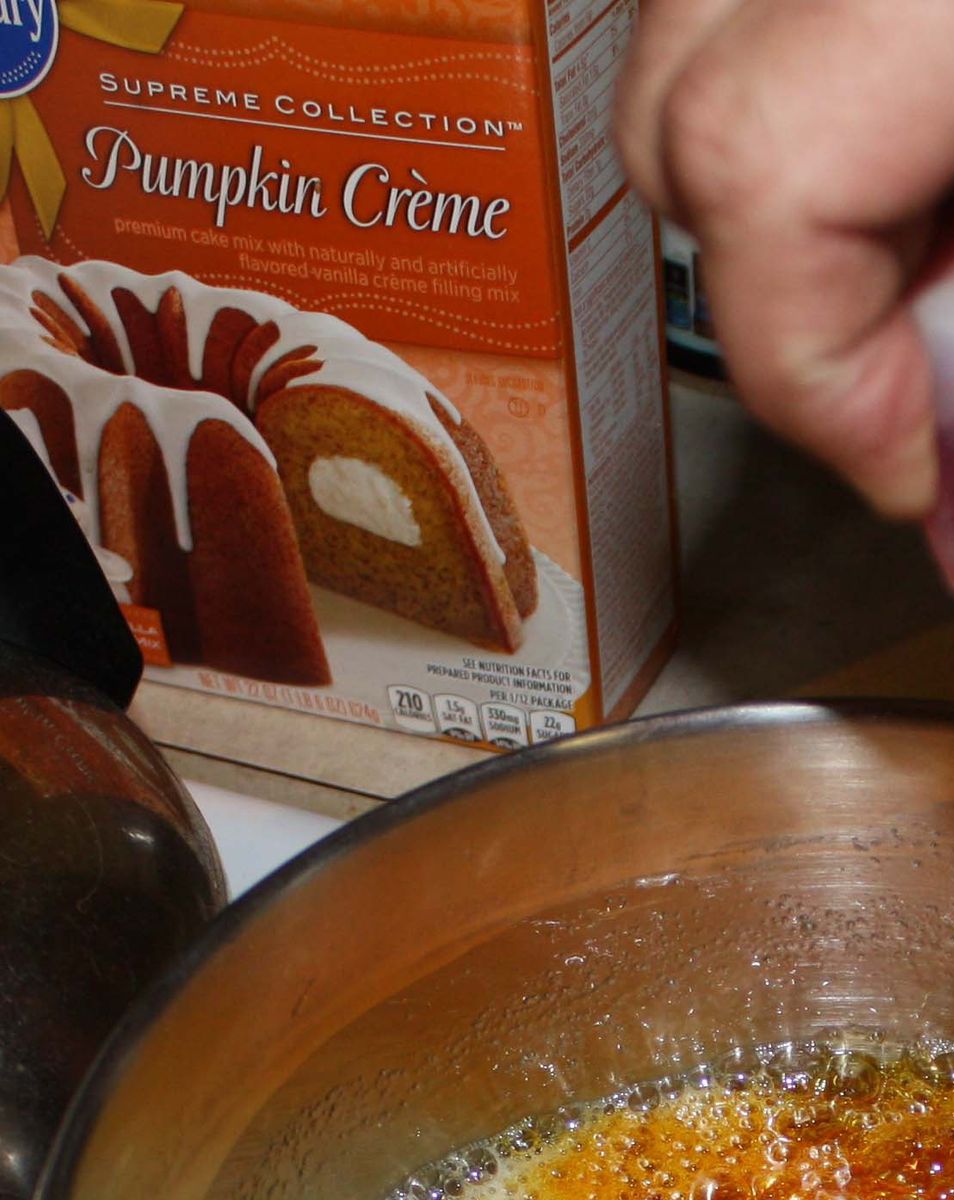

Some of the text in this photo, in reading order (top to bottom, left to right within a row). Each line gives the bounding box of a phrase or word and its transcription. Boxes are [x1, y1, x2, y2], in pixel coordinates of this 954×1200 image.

[99, 72, 261, 111] SUPREME
[82, 126, 327, 227] Pumpkin
[343, 163, 510, 239] Crème
[114, 217, 519, 285] premium cake mix with naturally and artificially
[373, 273, 428, 294] crème
[433, 277, 482, 303] filling
[488, 285, 521, 303] mix
[427, 664, 573, 695] PREPARED PRODUCT INFORMATION
[462, 657, 571, 682] SEE NUTRITION FACTS FOR
[396, 689, 424, 712] 210
[531, 696, 573, 711] PACKAGE
